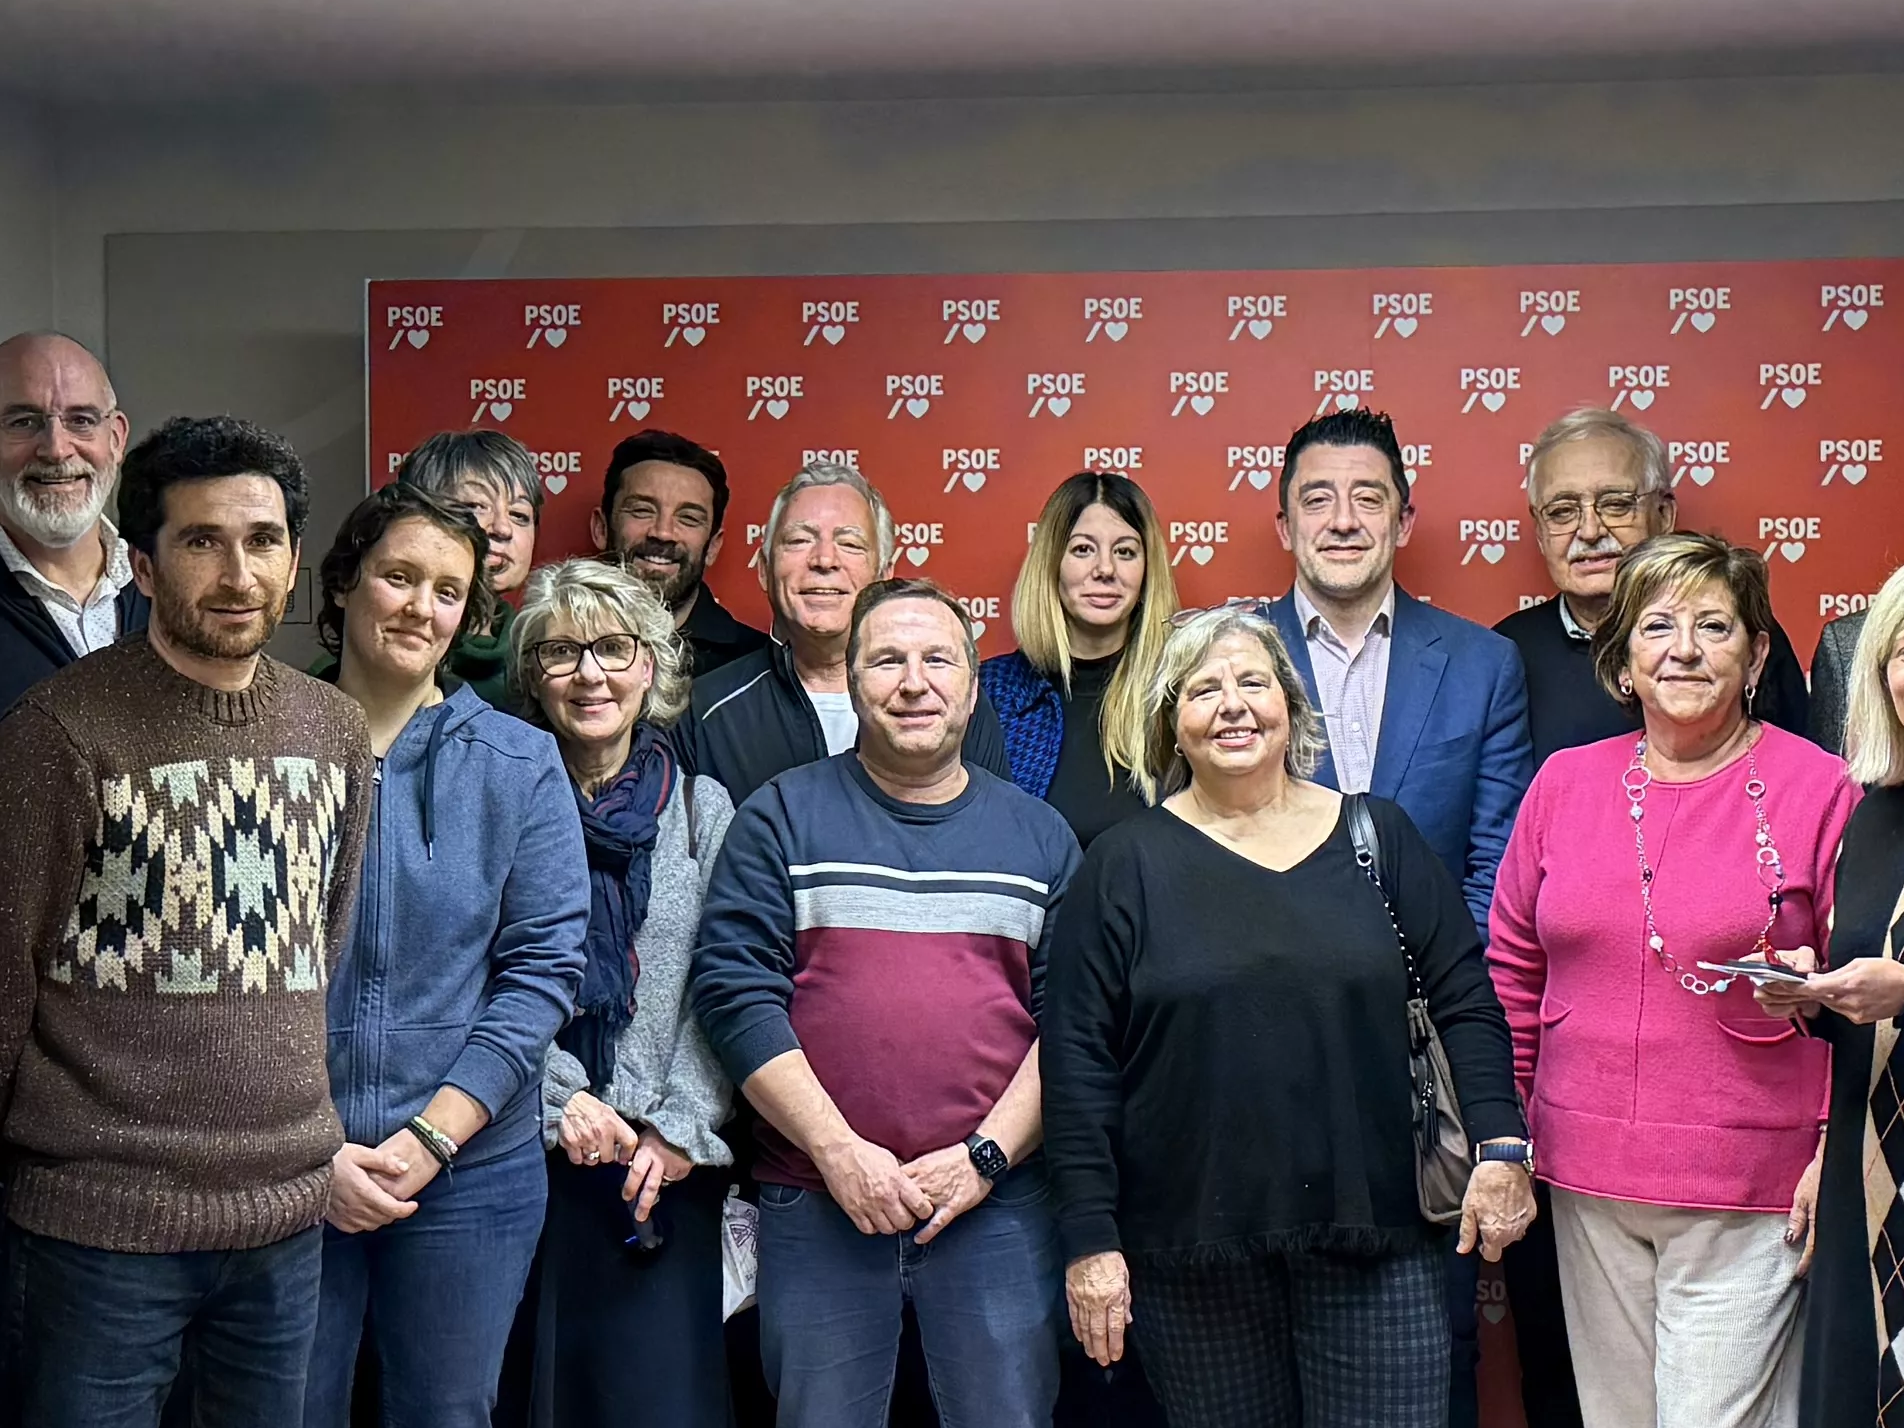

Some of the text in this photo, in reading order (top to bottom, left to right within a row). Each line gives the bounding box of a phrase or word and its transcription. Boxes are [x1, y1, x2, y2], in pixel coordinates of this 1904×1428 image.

[1227, 295, 1287, 318] PSOE
[1373, 292, 1433, 316] PSOE
[1520, 290, 1581, 314] PSOE
[1669, 287, 1731, 311] PSOE
[1821, 284, 1884, 308] PSOE
[387, 306, 444, 328] PSOE
[524, 304, 582, 326] PSOE
[663, 302, 720, 325] PSOE
[802, 301, 860, 323] PSOE
[942, 299, 1001, 322] PSOE
[1084, 297, 1143, 320] PSOE
[886, 374, 944, 397] PSOE
[1027, 372, 1086, 395] PSOE
[1170, 371, 1229, 393] PSOE
[1314, 369, 1374, 392] PSOE
[1460, 367, 1521, 390] PSOE
[1608, 365, 1670, 388] PSOE
[1759, 362, 1822, 386] PSOE
[470, 378, 527, 400] PSOE
[607, 377, 665, 399] PSOE
[746, 375, 804, 398] PSOE
[942, 448, 1001, 470] PSOE
[1084, 447, 1143, 469] PSOE
[1227, 445, 1287, 469] PSOE
[1401, 443, 1433, 467] OE
[1668, 441, 1730, 464] PSOE
[1820, 439, 1883, 463] PSOE
[1169, 521, 1229, 544] PSOE
[1459, 519, 1521, 542] PSOE
[1759, 517, 1821, 540] PSOE
[959, 596, 1001, 619] SOE
[1475, 1278, 1507, 1303] SO
